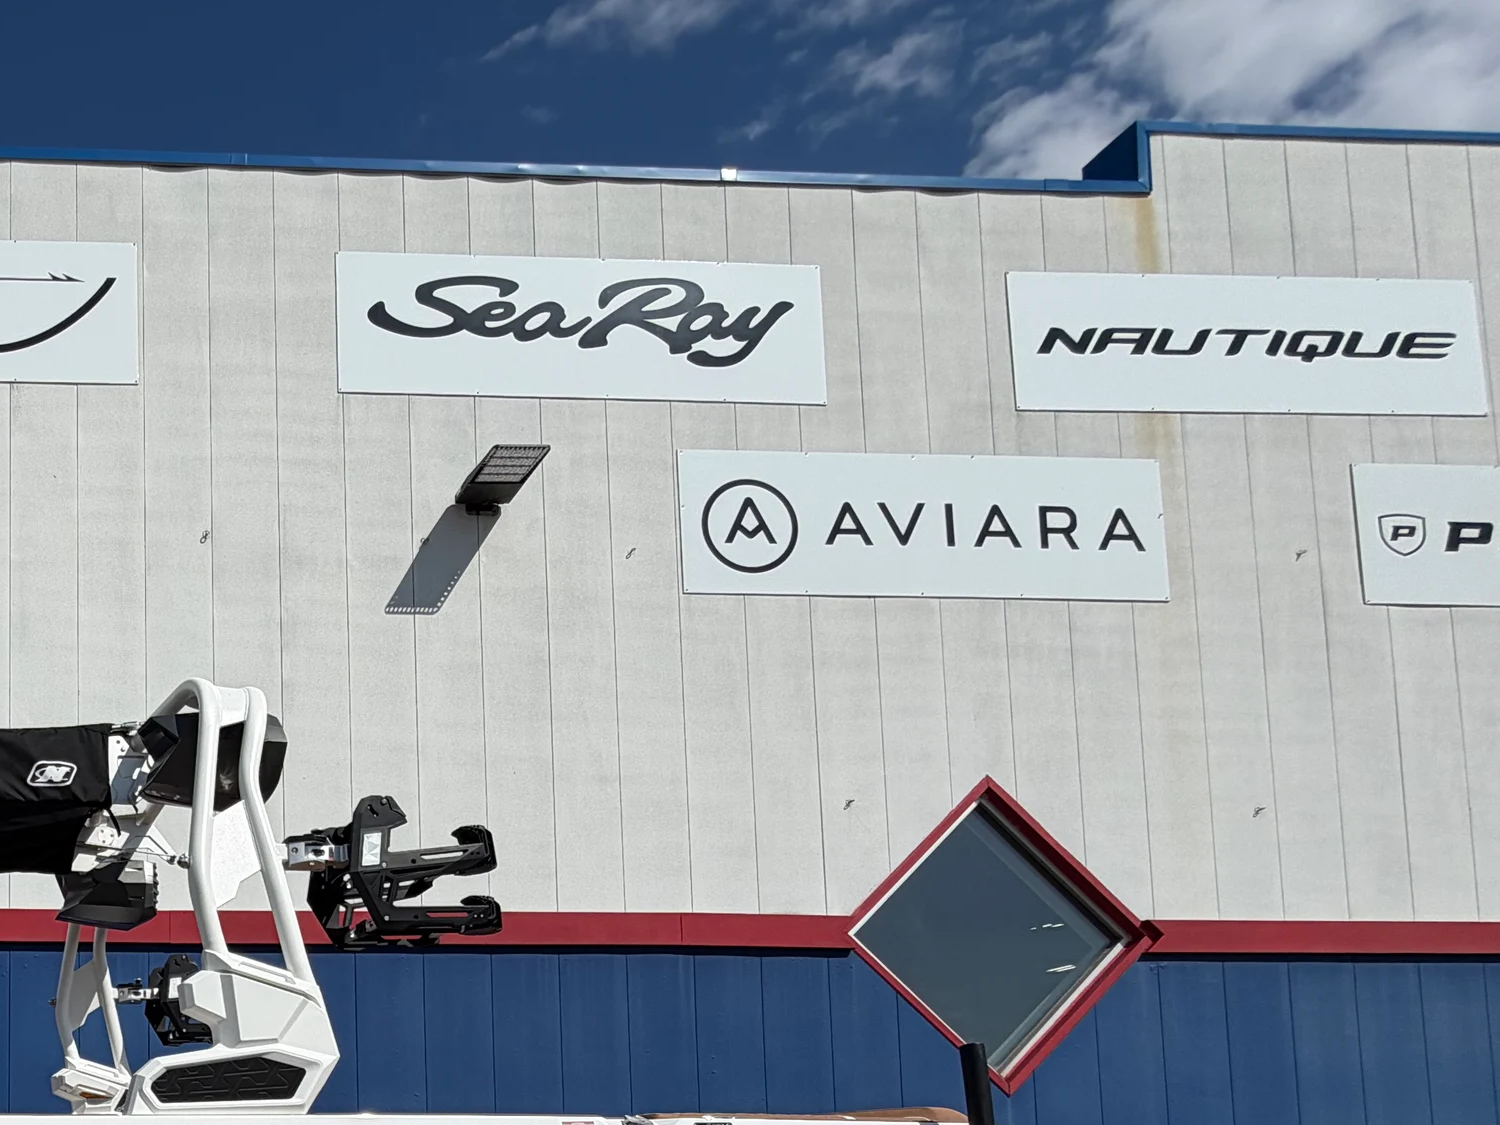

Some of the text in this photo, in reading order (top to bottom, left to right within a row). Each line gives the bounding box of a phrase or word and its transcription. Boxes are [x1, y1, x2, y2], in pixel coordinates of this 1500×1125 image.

[367, 275, 795, 368] Sea Ray
[1036, 326, 1457, 363] NAUTIQUE
[825, 501, 1146, 552] AVIARA
[1390, 525, 1417, 542] P
